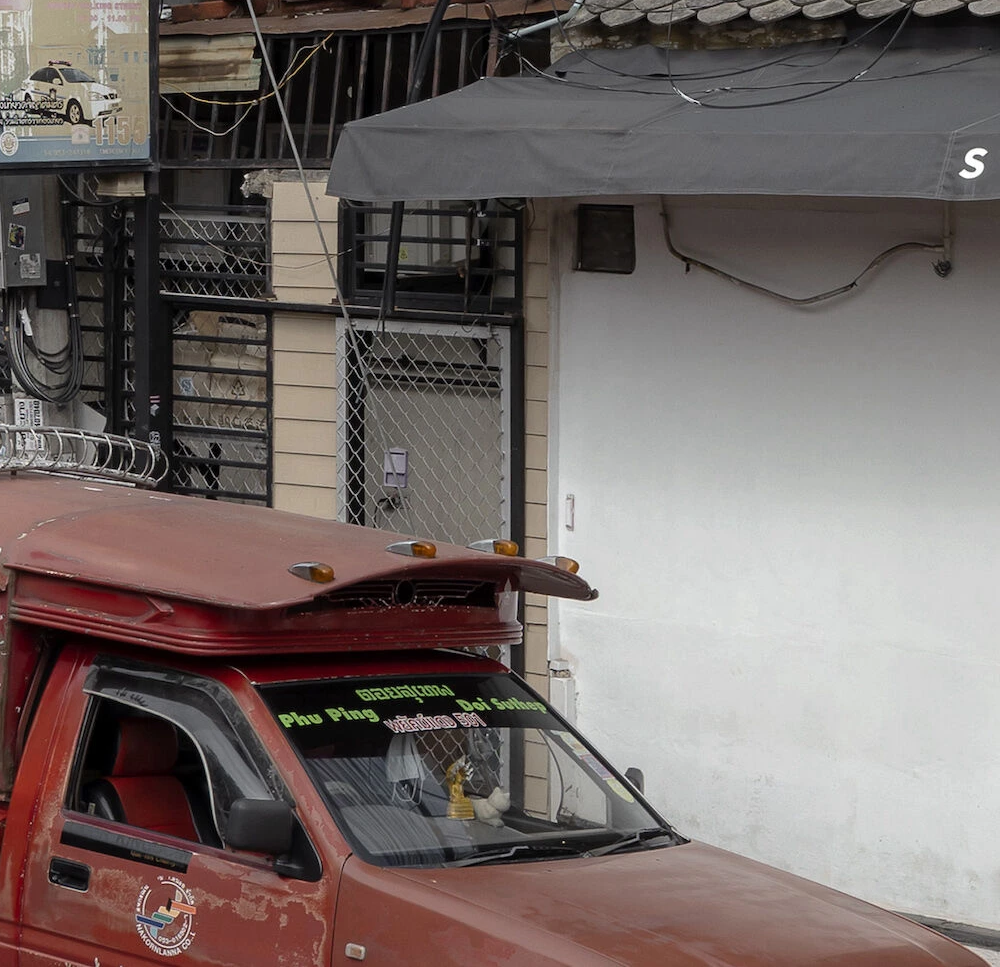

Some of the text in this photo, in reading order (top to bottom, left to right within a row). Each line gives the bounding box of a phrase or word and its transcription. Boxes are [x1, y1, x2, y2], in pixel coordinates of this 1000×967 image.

[958, 147, 989, 180] S
[455, 696, 548, 715] Doi Suthep
[277, 706, 381, 729] Phu Ping
[451, 711, 488, 728] 501
